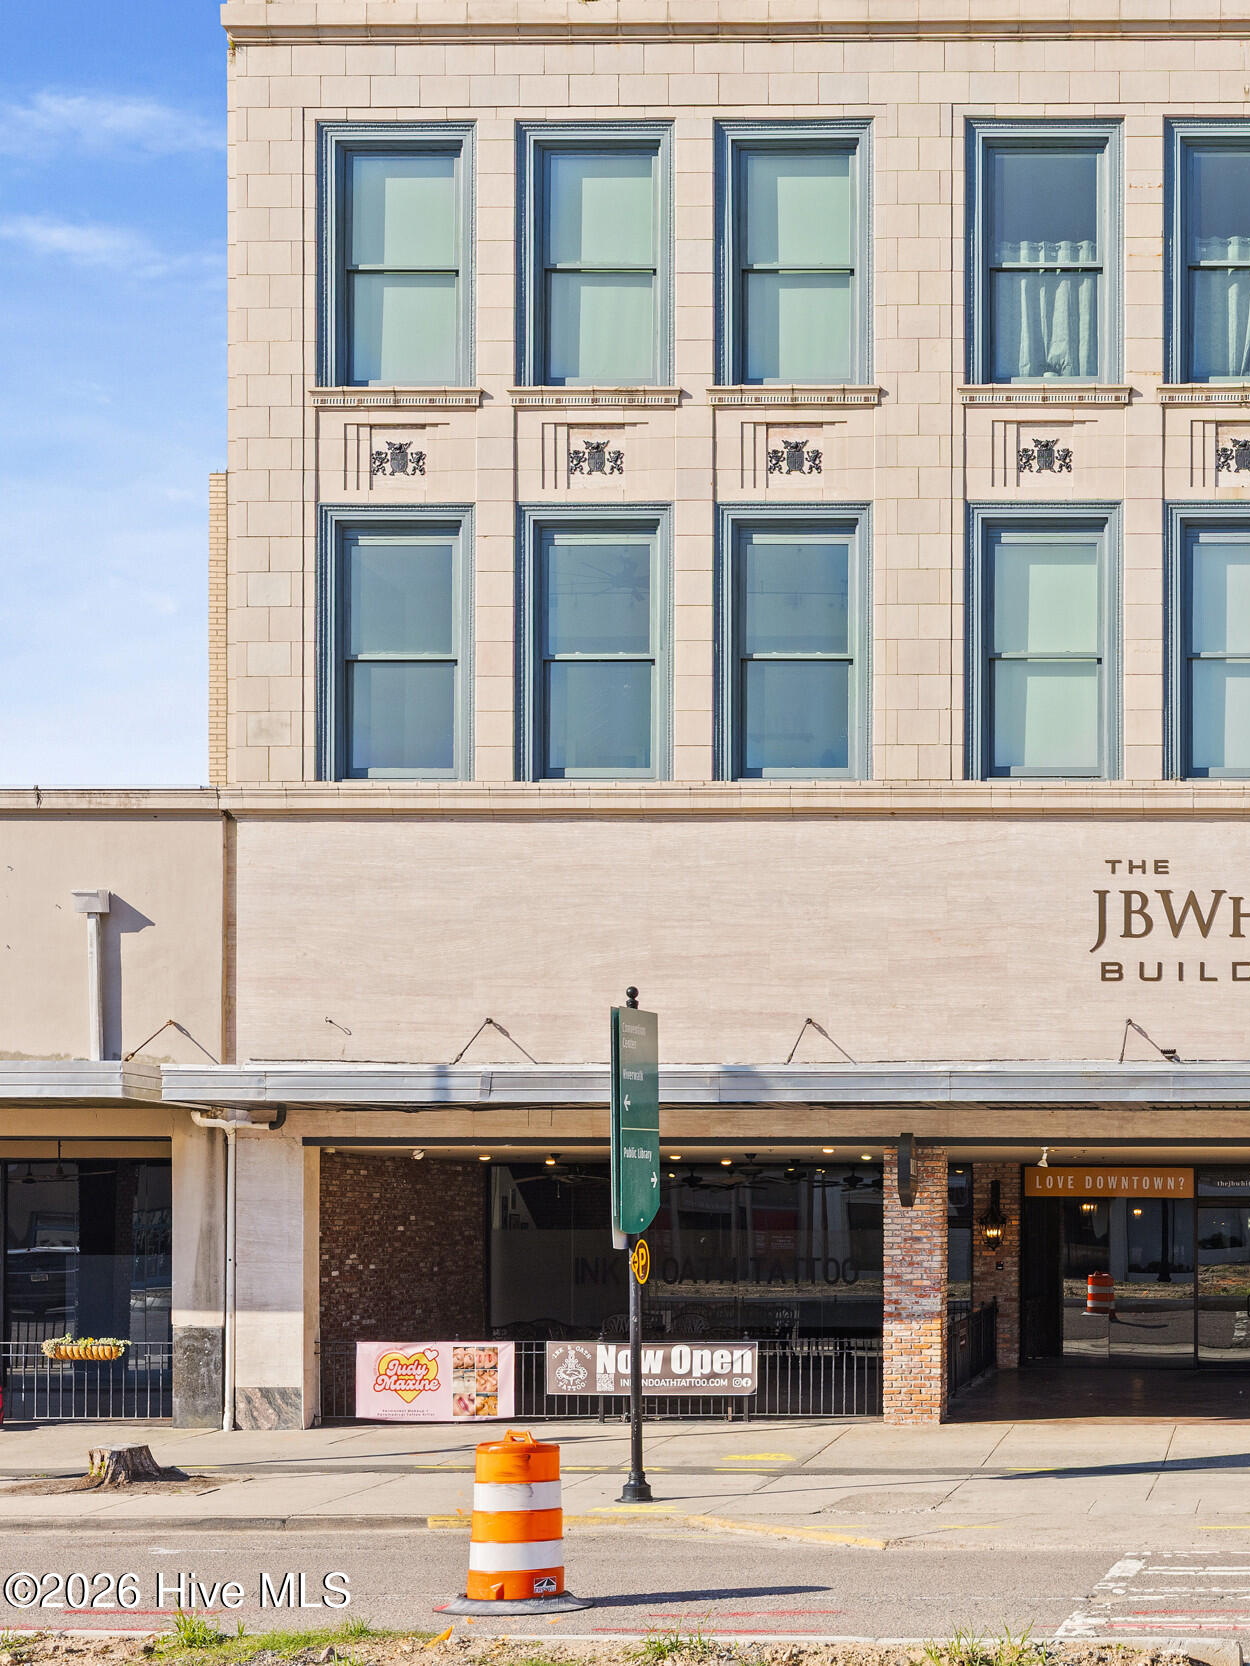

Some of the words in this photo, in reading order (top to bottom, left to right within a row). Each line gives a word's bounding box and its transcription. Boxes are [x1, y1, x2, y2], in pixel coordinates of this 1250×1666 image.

[1105, 859, 1170, 874] THE
[623, 1147, 637, 1159] Public
[637, 1147, 652, 1162] Library
[1035, 1175, 1075, 1189] LOVE
[1085, 1175, 1185, 1190] DOWNTOWN?
[575, 1256, 620, 1285] INK
[750, 1256, 860, 1285] TATTOO
[638, 1247, 647, 1277] P
[386, 1359, 429, 1380] Judy
[597, 1345, 664, 1374] Now
[671, 1345, 752, 1377] Open
[373, 1374, 441, 1392] Maxine
[621, 1379, 728, 1388] INNDOATHTATTOO.COM
